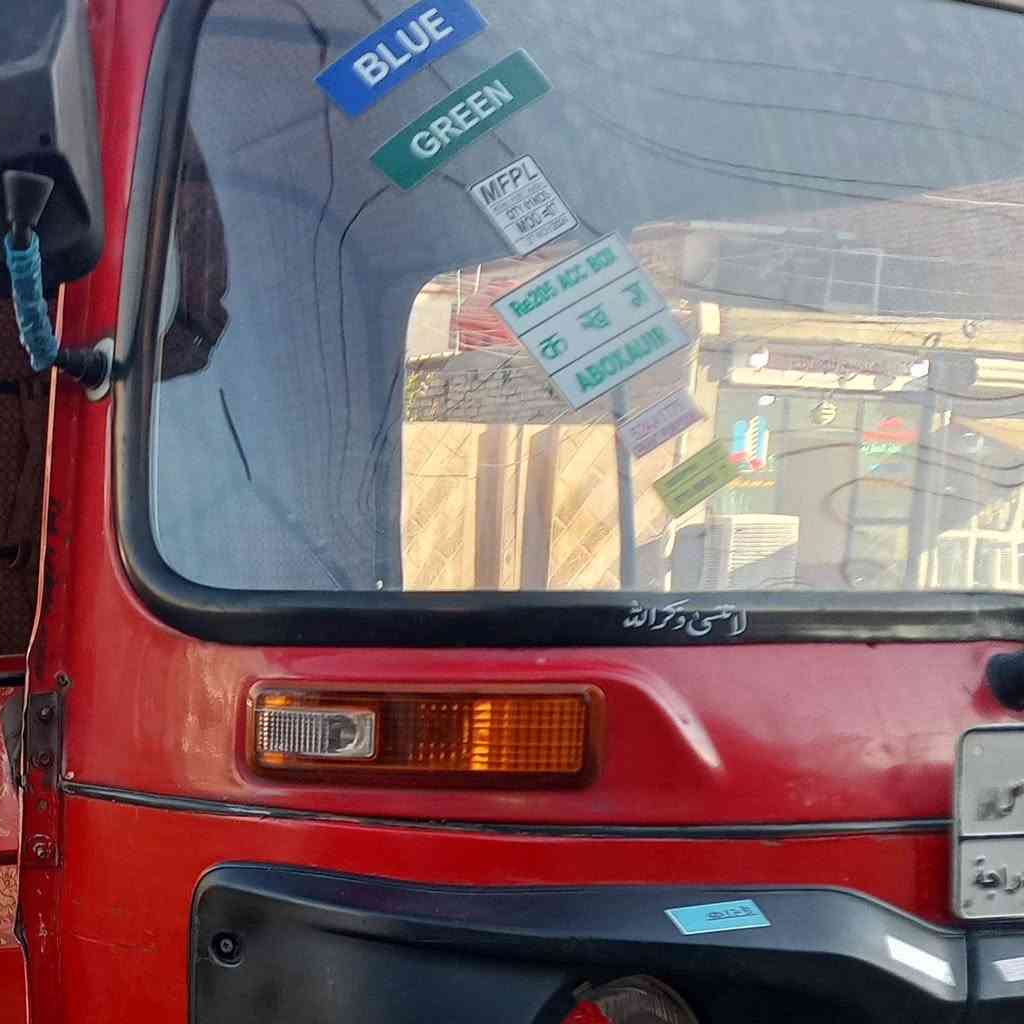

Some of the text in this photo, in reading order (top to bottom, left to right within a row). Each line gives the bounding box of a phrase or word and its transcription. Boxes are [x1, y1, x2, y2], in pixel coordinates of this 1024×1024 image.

[353, 7, 455, 87] BLUE
[411, 79, 514, 159] GREEN
[479, 162, 538, 206] MFPL
